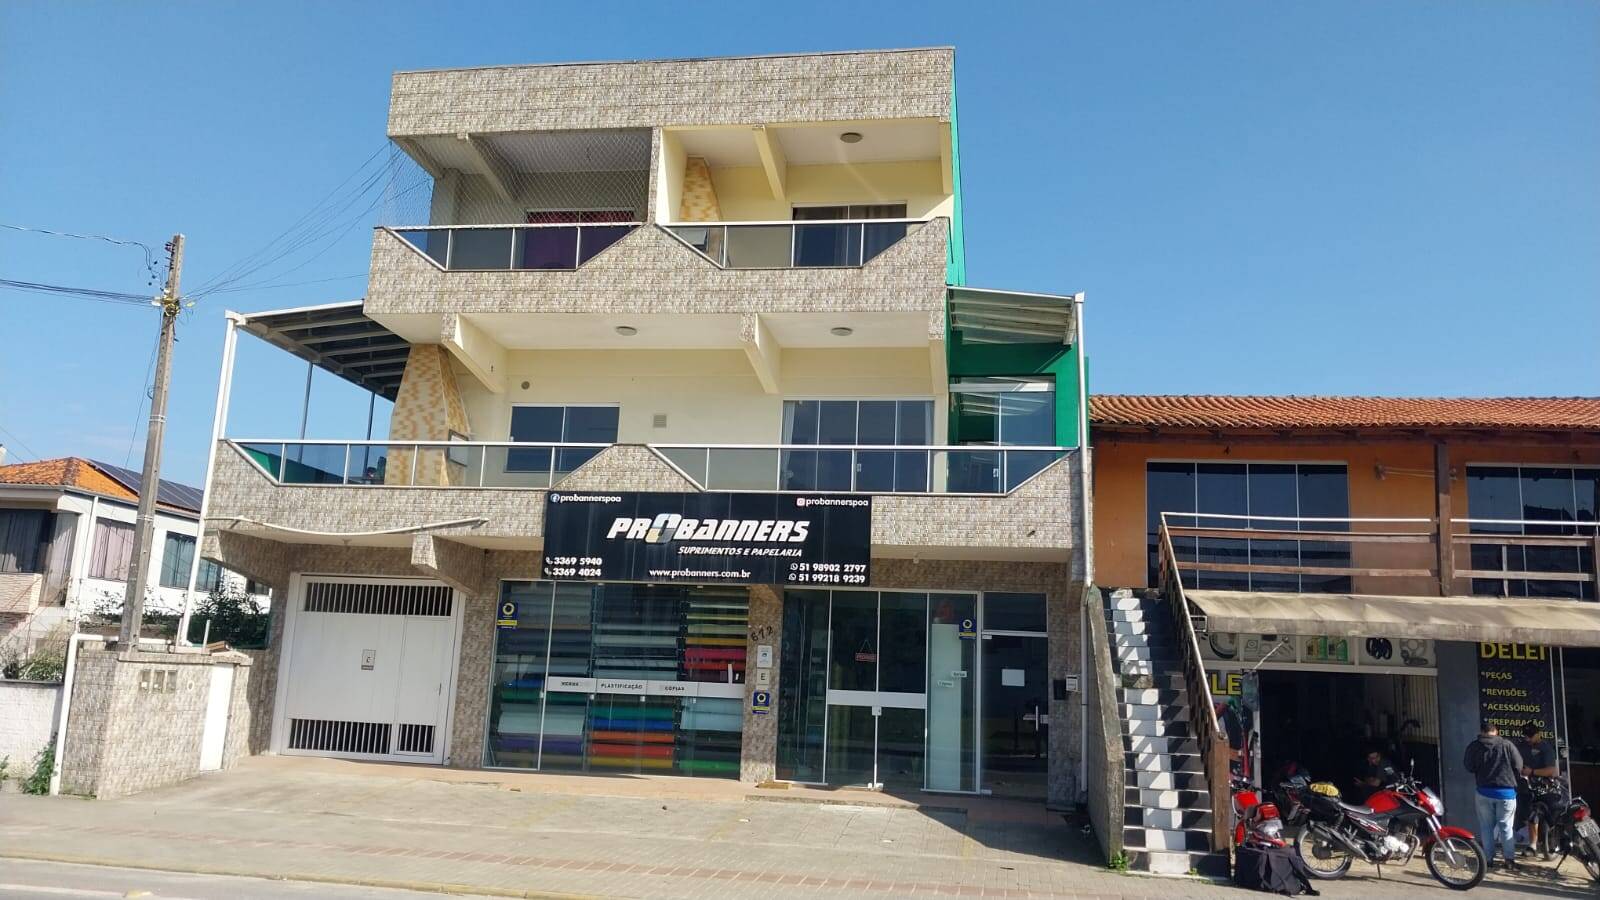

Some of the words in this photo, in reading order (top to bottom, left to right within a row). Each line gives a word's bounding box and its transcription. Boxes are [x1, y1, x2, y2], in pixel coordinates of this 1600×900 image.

[560, 494, 622, 504] probannerspoa
[805, 498, 869, 508] probannerspoa
[677, 546, 741, 556] SUPRIMENTOS
[742, 548, 749, 556] E
[750, 548, 802, 557] PAPELARIA
[553, 557, 577, 565] 3369
[579, 557, 603, 566] 5940
[552, 567, 576, 576] 3369
[578, 568, 602, 577] 4024
[799, 563, 810, 571] 51
[812, 563, 840, 572] 98902
[843, 564, 867, 573] 2797
[649, 568, 751, 579] www.probanners.com.br
[798, 574, 809, 582] 51
[811, 574, 840, 583] 99218
[842, 575, 866, 583] 9239
[1486, 672, 1512, 680] PEÇAS
[1486, 687, 1527, 697] REVISÕES
[1487, 703, 1541, 713] ACESSÓRIOS
[1499, 729, 1511, 737] DE
